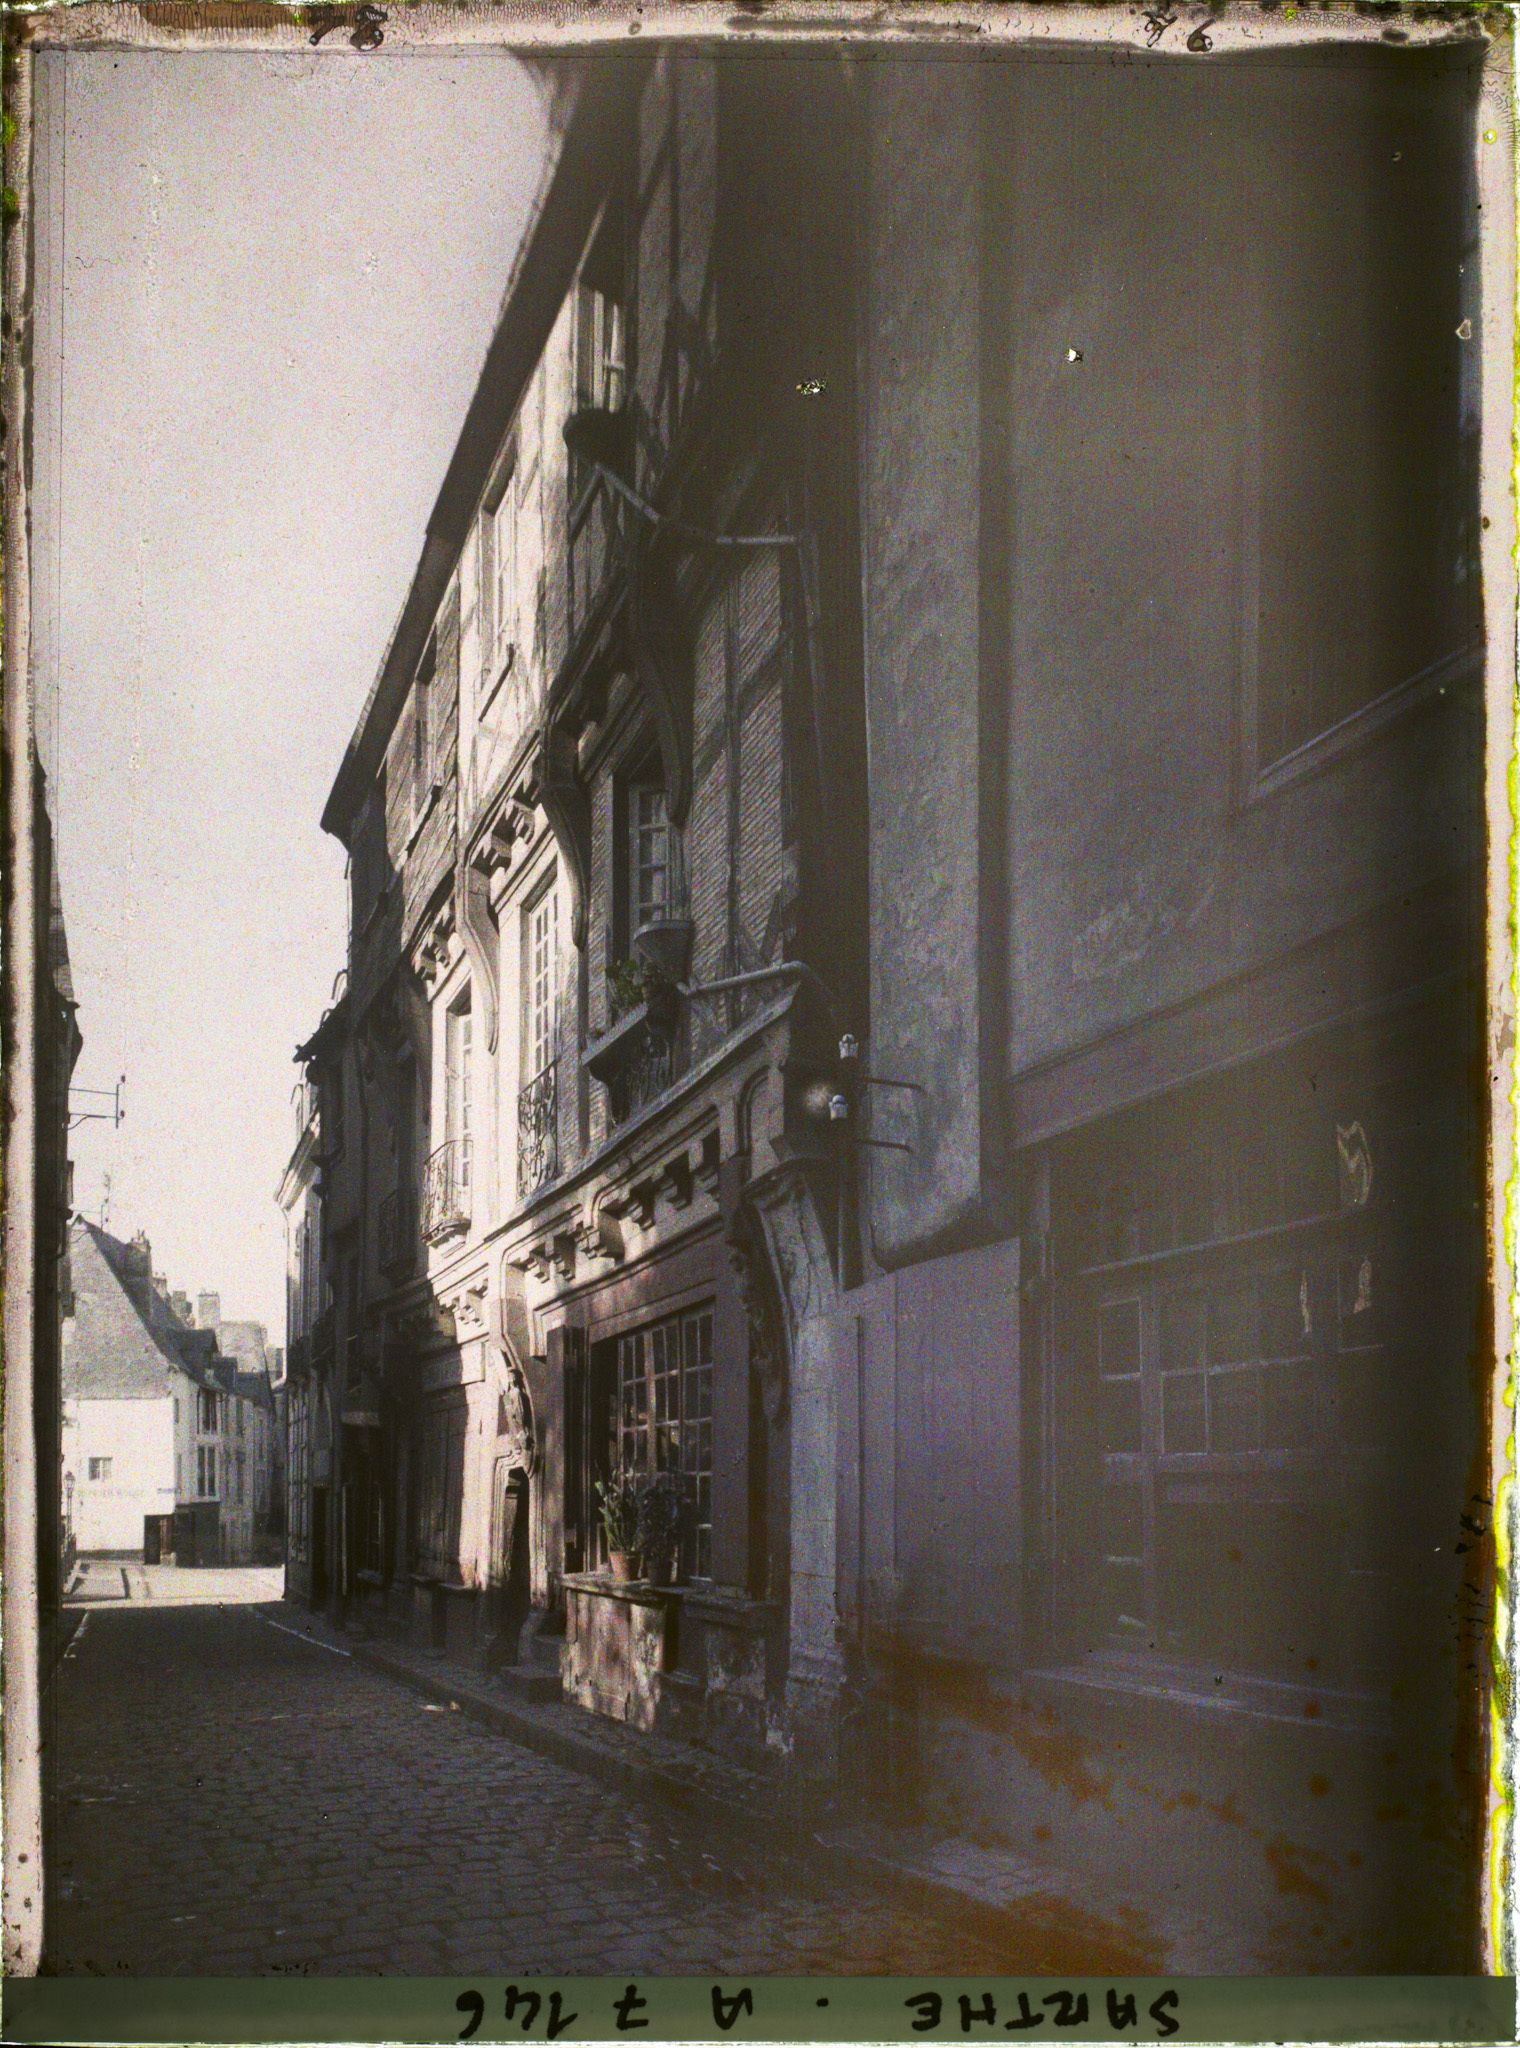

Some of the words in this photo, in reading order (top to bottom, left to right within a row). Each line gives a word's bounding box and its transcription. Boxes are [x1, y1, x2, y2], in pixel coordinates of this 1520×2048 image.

[455, 1984, 579, 2041] 146
[612, 1983, 649, 2031] 7
[712, 1985, 754, 2031] A
[904, 1986, 1180, 2038] SARTHE
